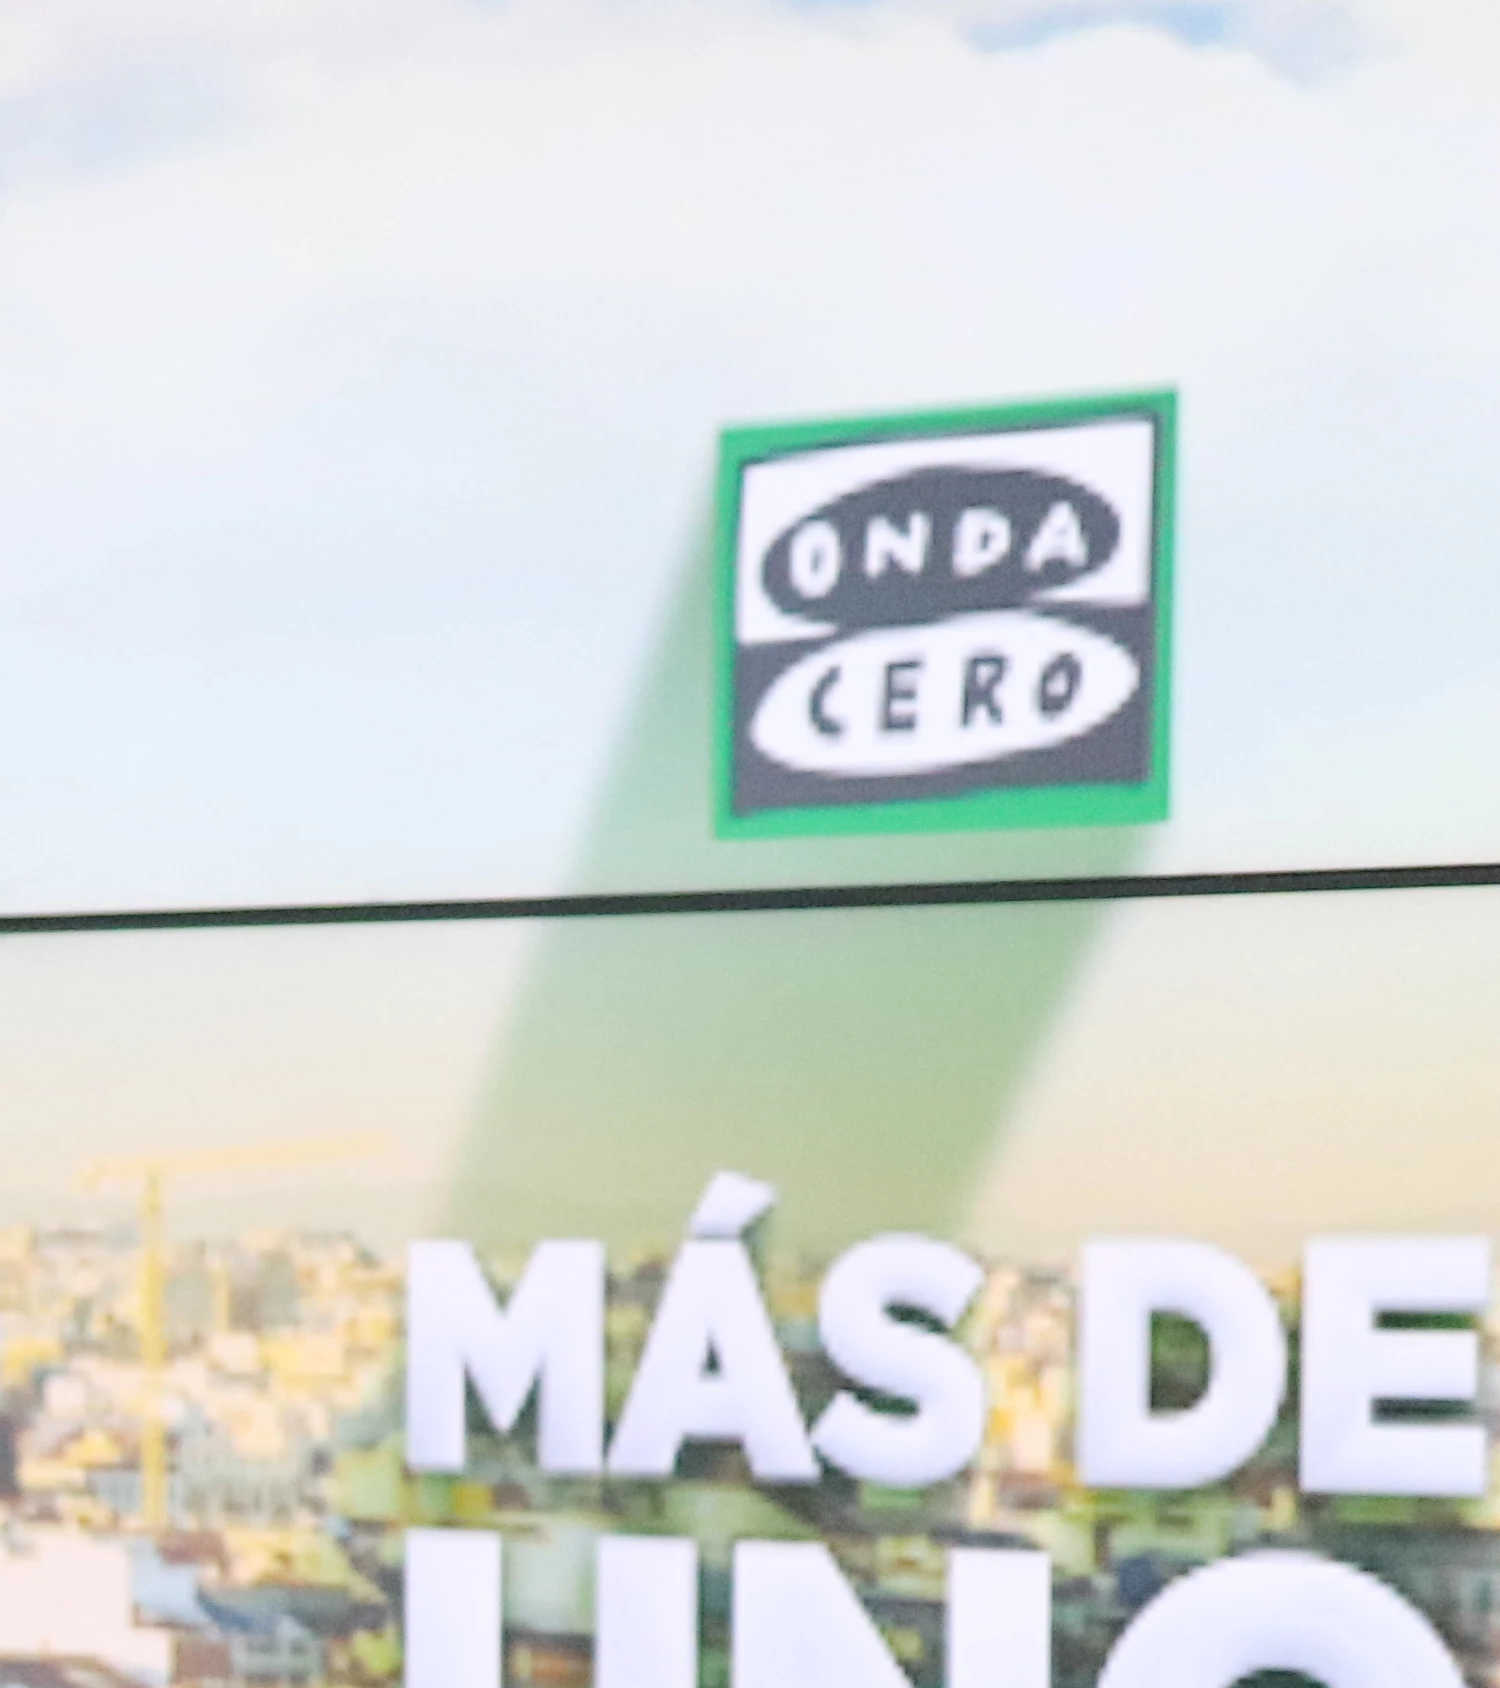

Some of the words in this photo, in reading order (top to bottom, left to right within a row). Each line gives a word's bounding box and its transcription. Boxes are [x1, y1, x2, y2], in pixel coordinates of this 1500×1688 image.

[789, 500, 1088, 599] ONDA
[807, 650, 1083, 738] CERO
[405, 1170, 988, 1489] MÁS
[1077, 1233, 1492, 1496] DE
